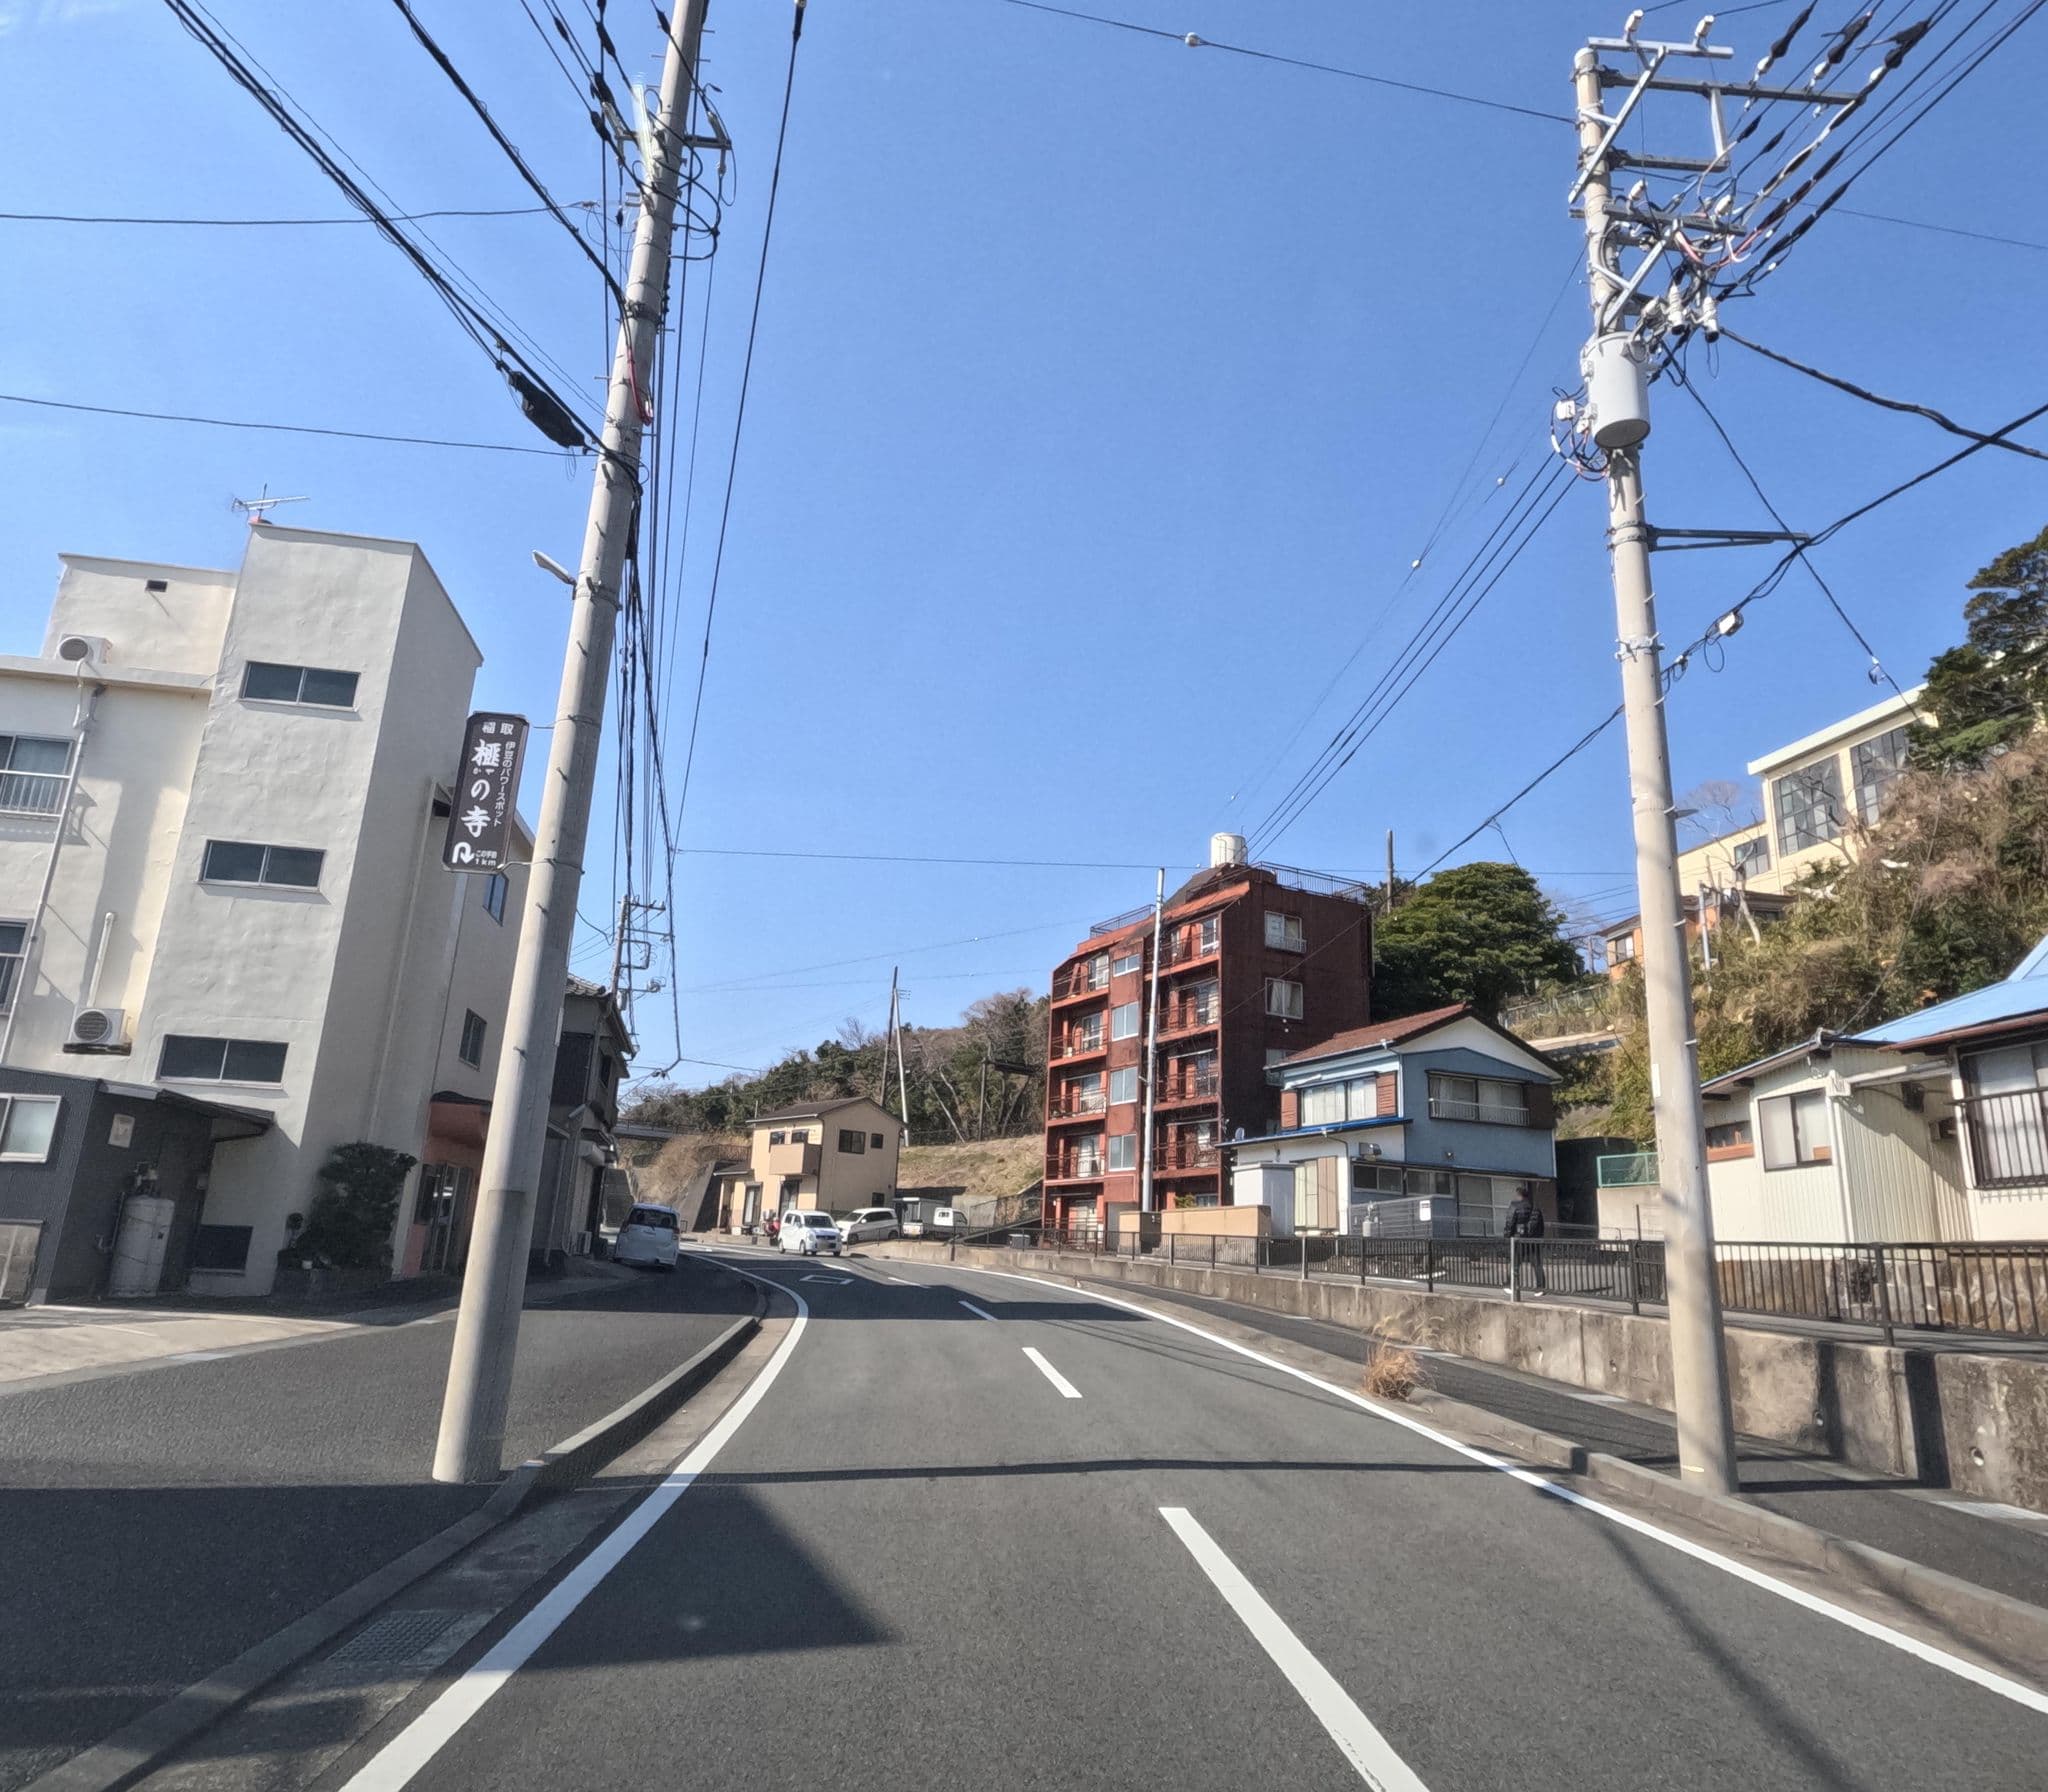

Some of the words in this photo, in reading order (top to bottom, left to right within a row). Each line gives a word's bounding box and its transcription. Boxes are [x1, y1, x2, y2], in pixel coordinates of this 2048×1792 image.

[482, 722, 514, 735] 稲取
[493, 741, 516, 827] 伊豆のパワースポット
